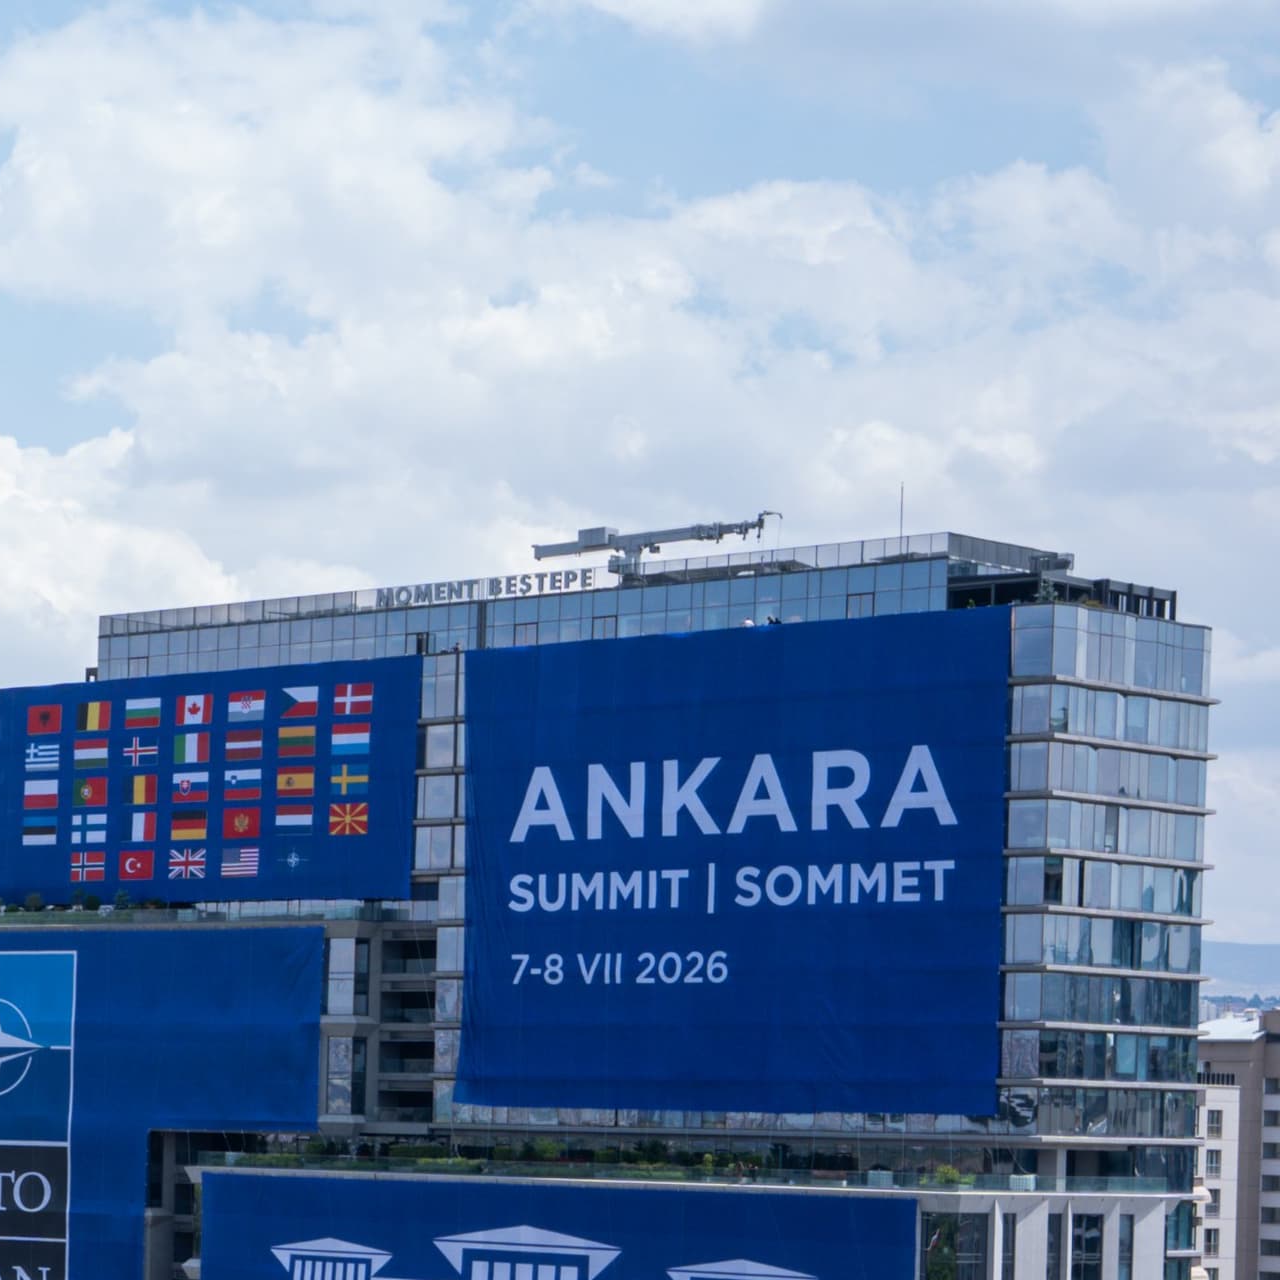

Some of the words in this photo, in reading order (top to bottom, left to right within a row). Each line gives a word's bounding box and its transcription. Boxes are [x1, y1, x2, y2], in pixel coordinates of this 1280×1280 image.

[375, 579, 479, 608] MOMENT
[488, 567, 594, 597] BEŞTEPE
[509, 744, 959, 842] ANKARA
[508, 869, 689, 912] SUMMIT
[734, 860, 956, 907] SOMMET
[511, 954, 564, 985] 7-8
[577, 953, 622, 985] VII
[635, 951, 729, 984] 2026
